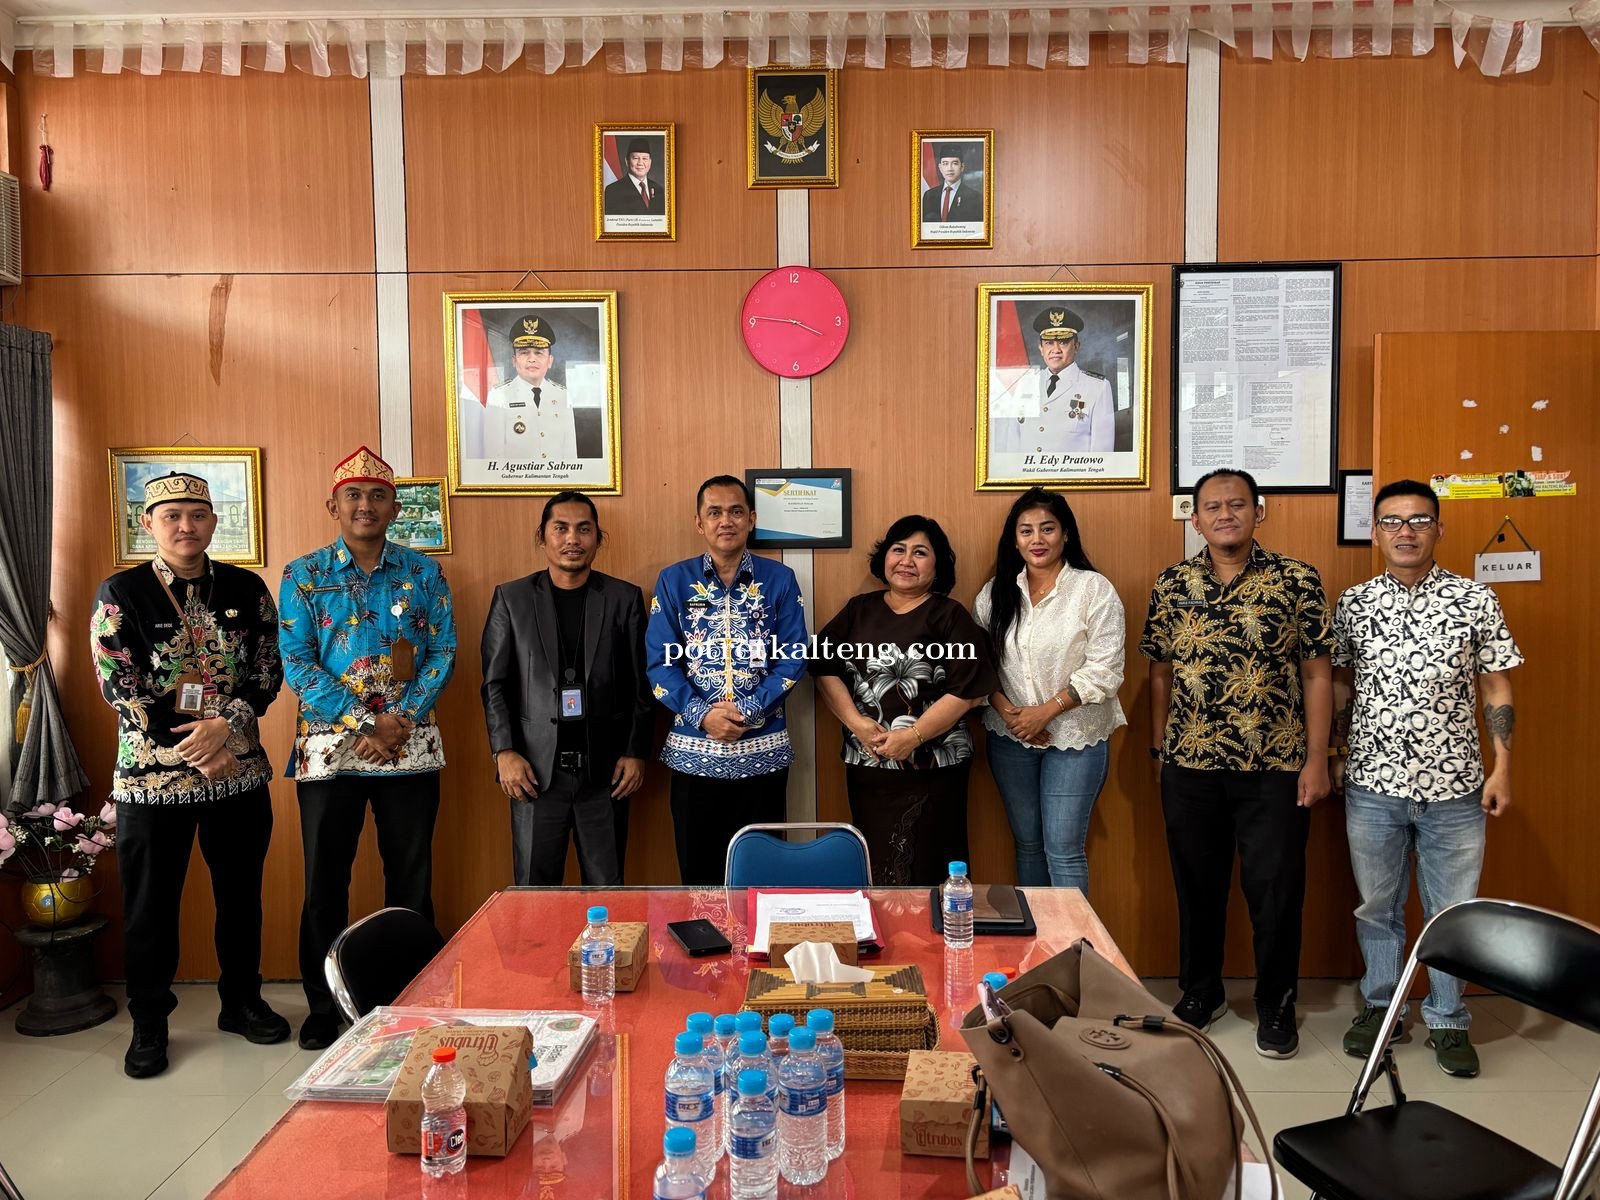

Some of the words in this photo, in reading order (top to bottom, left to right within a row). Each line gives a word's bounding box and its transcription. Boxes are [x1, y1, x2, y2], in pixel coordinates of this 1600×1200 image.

[789, 272, 799, 284] 12
[748, 318, 756, 328] 9
[835, 316, 842, 326] 3
[792, 361, 800, 371] 6
[1024, 455, 1036, 464] H.
[1040, 455, 1060, 466] Edy
[1062, 454, 1104, 464] Pratowo
[488, 461, 499, 471] H.
[502, 461, 545, 472] Agustiar
[546, 460, 583, 471] Sabran
[1482, 562, 1532, 571] KELUAR
